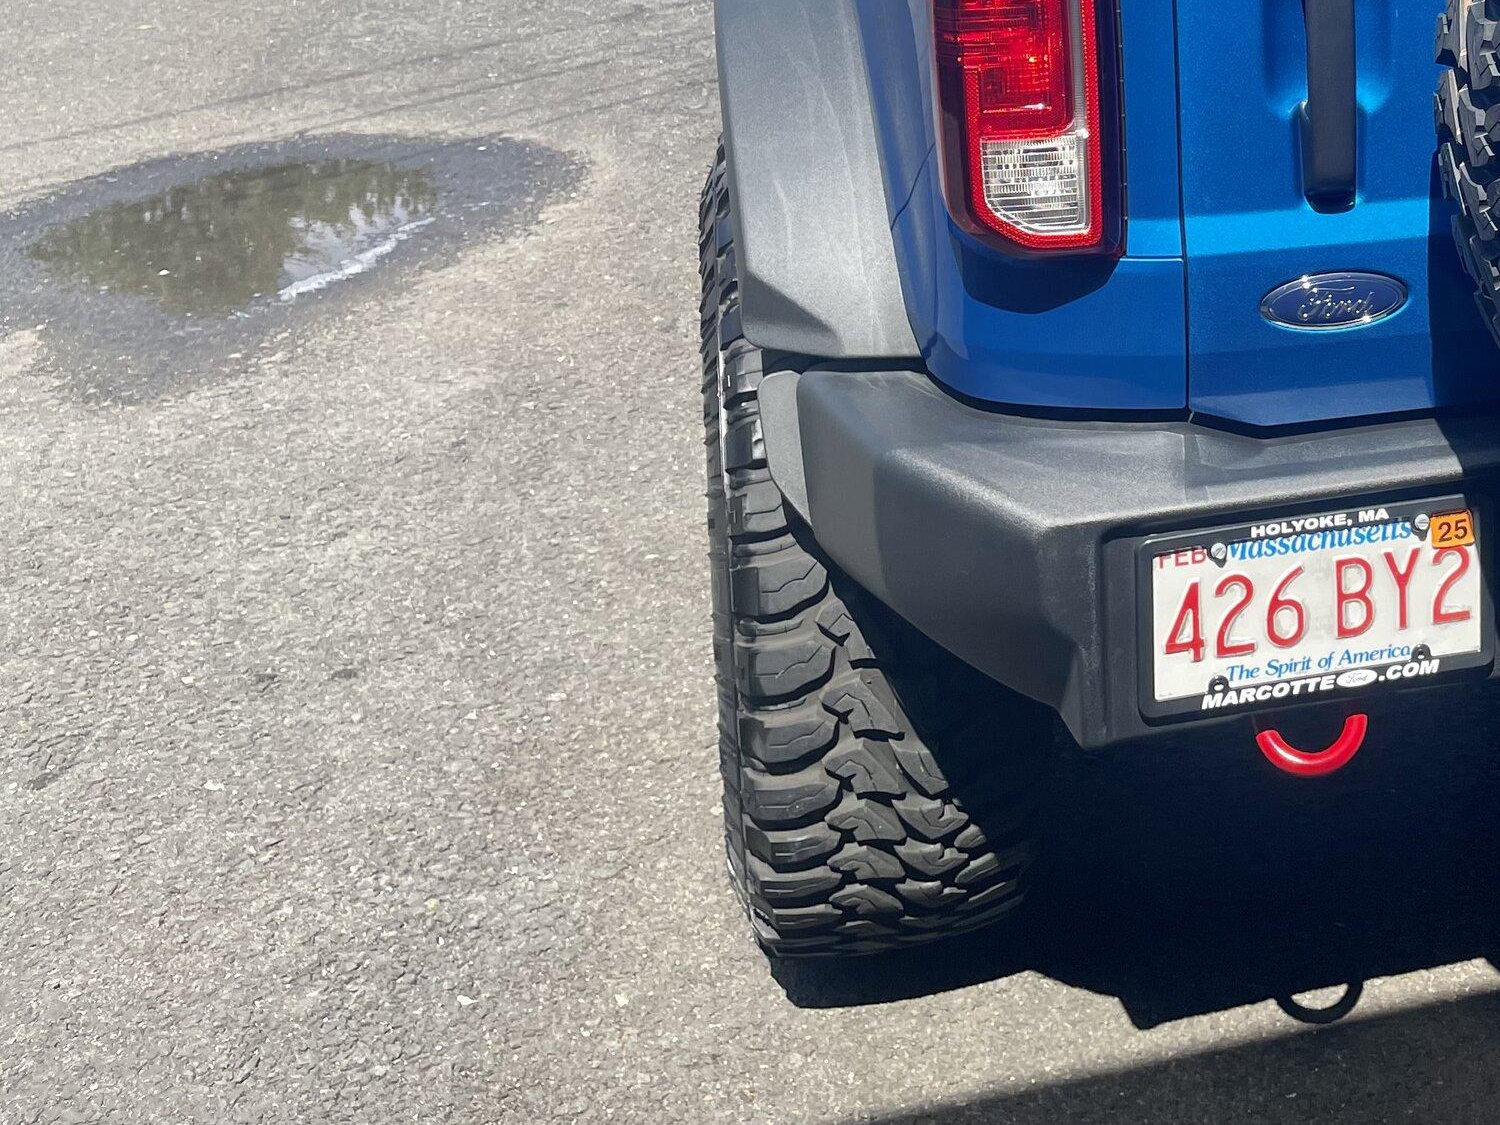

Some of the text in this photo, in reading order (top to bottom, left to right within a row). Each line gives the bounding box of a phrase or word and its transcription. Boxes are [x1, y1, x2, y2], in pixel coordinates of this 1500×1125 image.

[1296, 286, 1375, 321] Ford
[1250, 508, 1390, 539] HOLYOKE, MA
[1437, 518, 1470, 544] 25
[1157, 548, 1208, 570] FEB
[1164, 546, 1472, 663] 426 BY2
[1227, 644, 1412, 683] The Spirit of America
[1201, 659, 1440, 710] MARCOTTE Ford .COM
